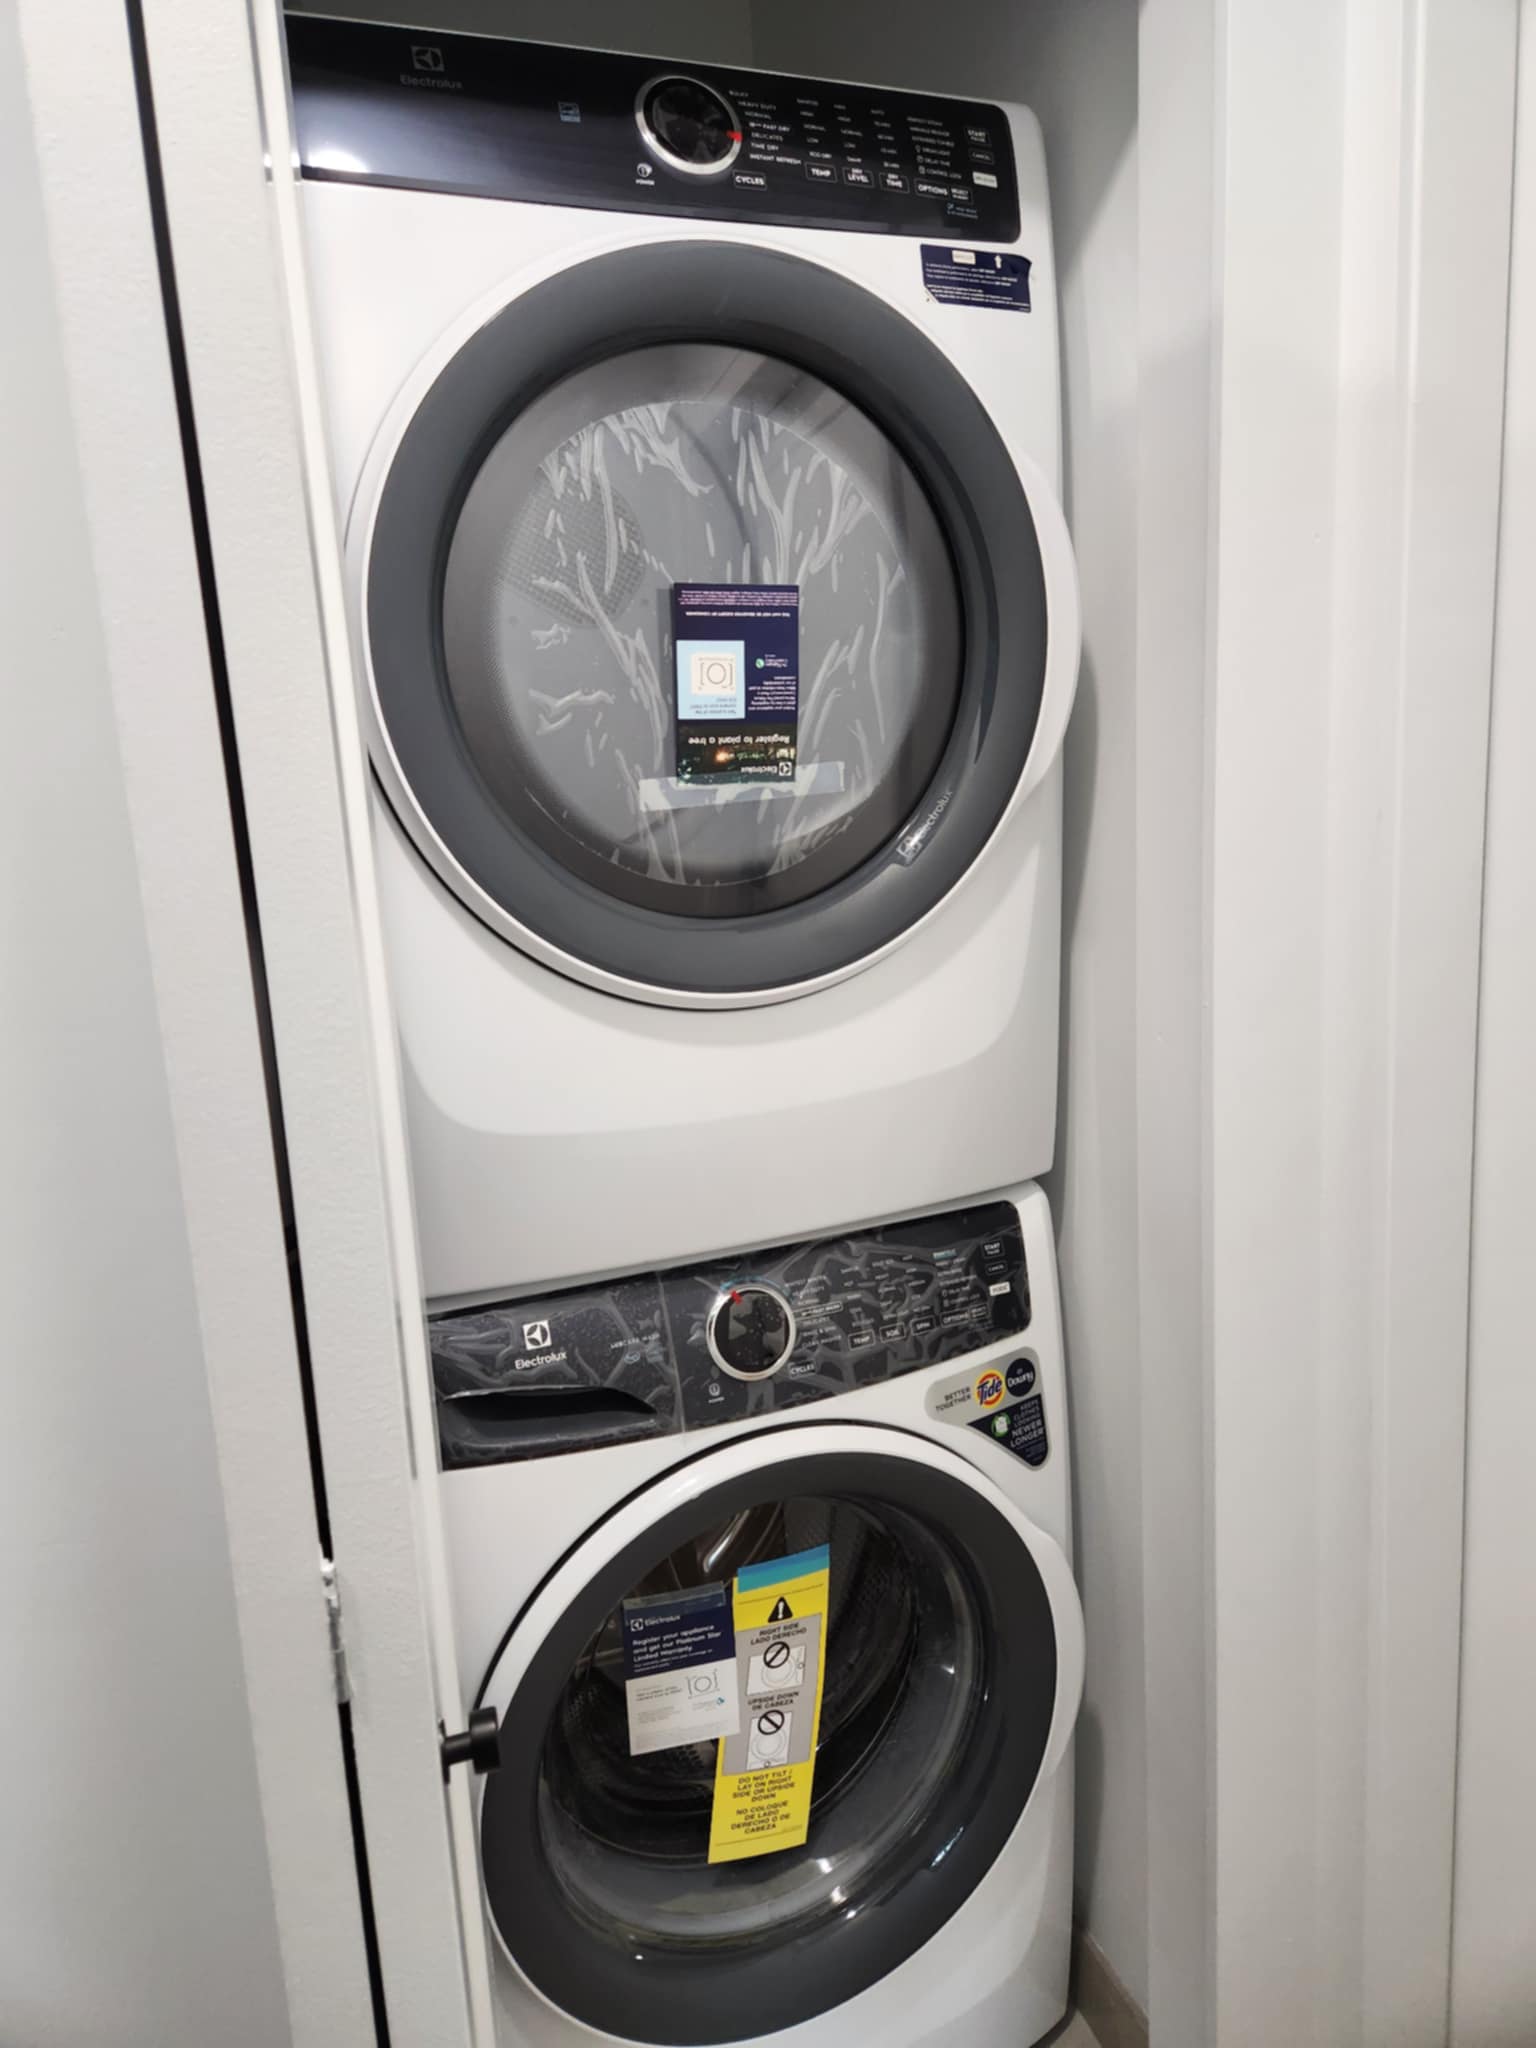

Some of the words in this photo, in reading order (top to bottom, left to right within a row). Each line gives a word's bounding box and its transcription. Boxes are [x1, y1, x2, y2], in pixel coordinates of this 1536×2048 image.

[400, 74, 463, 89] Electrolux
[811, 167, 831, 178] TEMP
[735, 175, 765, 186] CYCLES
[886, 179, 903, 189] TIME
[918, 183, 949, 196] OPTIONS
[687, 736, 707, 746] tree
[708, 736, 717, 744] a
[718, 735, 742, 745] plant
[743, 736, 754, 745] to
[755, 733, 791, 745] Register
[915, 1321, 931, 1331] SPIN
[853, 1335, 871, 1345] TEMP
[514, 1351, 568, 1371] Electrolux
[1006, 1370, 1035, 1389] Downy
[944, 1386, 971, 1401] BETTER
[976, 1374, 1003, 1406] Tide
[935, 1394, 972, 1412] TOGETHER
[1011, 1419, 1043, 1438] NEWER
[1009, 1427, 1045, 1449] LONGER
[632, 1636, 661, 1647] Register
[662, 1632, 679, 1641] your
[680, 1624, 715, 1637] appliance
[750, 1635, 771, 1646] LADO
[772, 1626, 808, 1641] DERECHO
[759, 1626, 781, 1637] RIGHT
[783, 1622, 799, 1631] SIDE
[632, 1646, 648, 1655] and
[648, 1643, 661, 1653] get
[662, 1641, 675, 1649] our
[676, 1634, 706, 1645] Platinum
[633, 1651, 659, 1663] Limited
[660, 1645, 693, 1657] Warranty
[747, 1695, 775, 1706] UPSIDE
[776, 1691, 800, 1701] DOWN
[751, 1702, 763, 1712] DE
[764, 1698, 795, 1710] CABEZA
[737, 1783, 752, 1792] LAY
[754, 1781, 766, 1789] ON
[767, 1774, 792, 1786] RIGHT
[738, 1776, 752, 1786] DO
[752, 1772, 769, 1782] NOT
[771, 1769, 787, 1779] TILT
[732, 1790, 751, 1800] SIDE
[752, 1787, 766, 1796] OR
[766, 1780, 796, 1793] UPSIDE
[751, 1793, 776, 1804] DOWN
[735, 1807, 749, 1817] NO
[749, 1799, 788, 1814] COLOQUE
[744, 1813, 755, 1822] DE
[757, 1808, 780, 1820] LADO
[730, 1817, 770, 1832] DERECHO
[771, 1814, 778, 1823] O
[779, 1812, 791, 1822] DE
[743, 1822, 777, 1835] CABEZA
